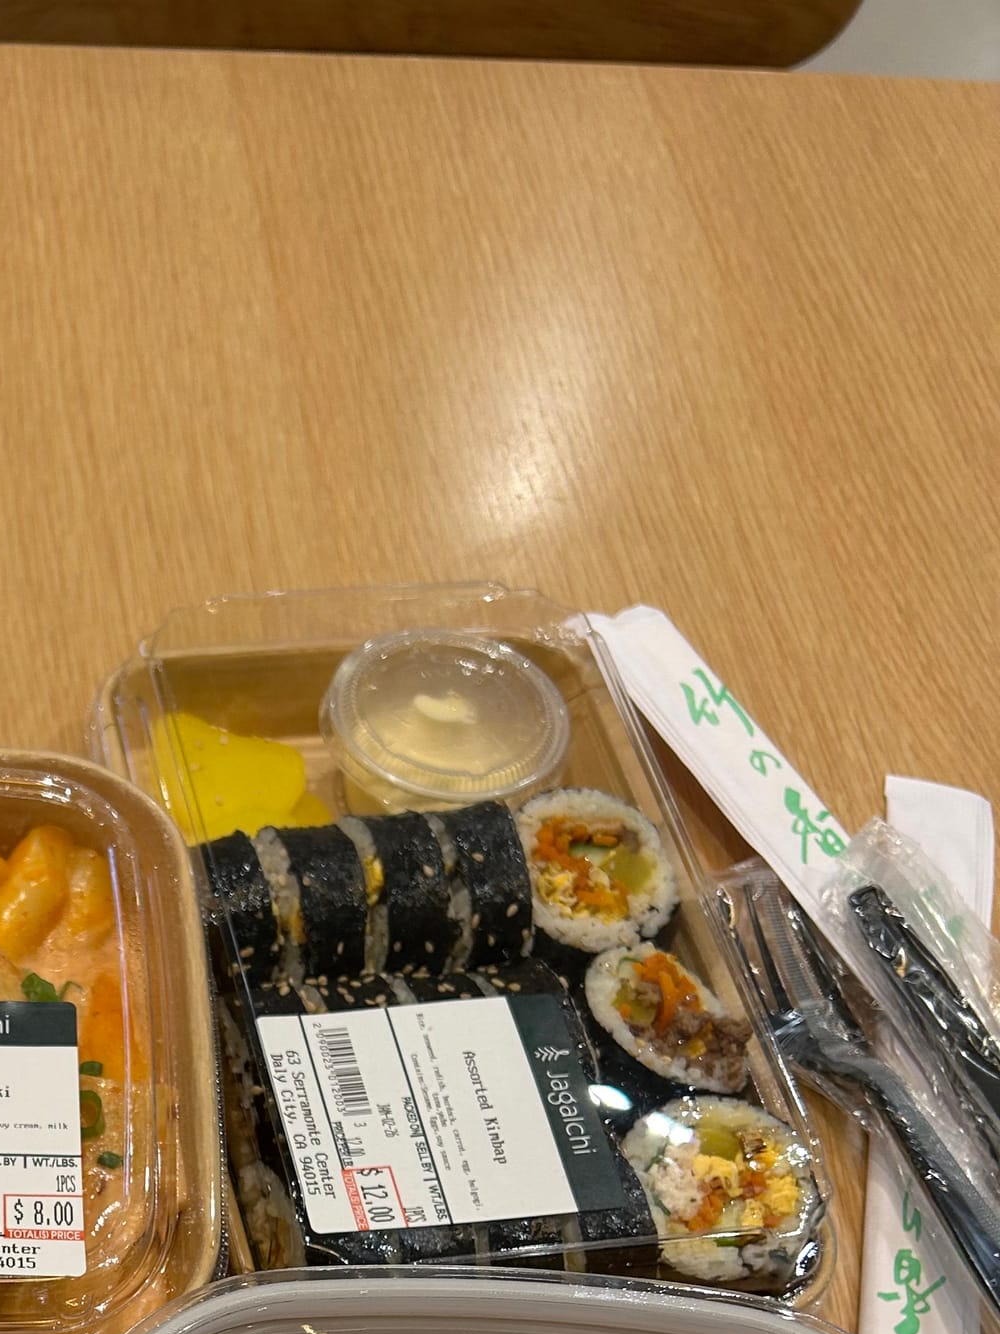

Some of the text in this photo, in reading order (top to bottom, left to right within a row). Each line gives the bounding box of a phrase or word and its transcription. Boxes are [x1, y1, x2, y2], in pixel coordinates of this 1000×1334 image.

[401, 1096, 417, 1123] PACKED
[462, 1051, 506, 1164] Assorted Kimbap
[546, 1070, 596, 1154] Jagalchi
[47, 1122, 68, 1130] milk
[269, 1053, 321, 1195] Daly City, CA 94015
[285, 1050, 336, 1199] 63 Serramonte Center
[3, 1156, 16, 1166] BY
[32, 1157, 77, 1168] WT./LBS.
[414, 1141, 428, 1161] SELL
[420, 1162, 432, 1172] BY
[55, 1174, 75, 1192] 1PCS
[356, 1167, 395, 1222] $ 12.00
[14, 1198, 73, 1226] $ 8.00
[8, 1228, 81, 1241] TOTAL($) PRICE
